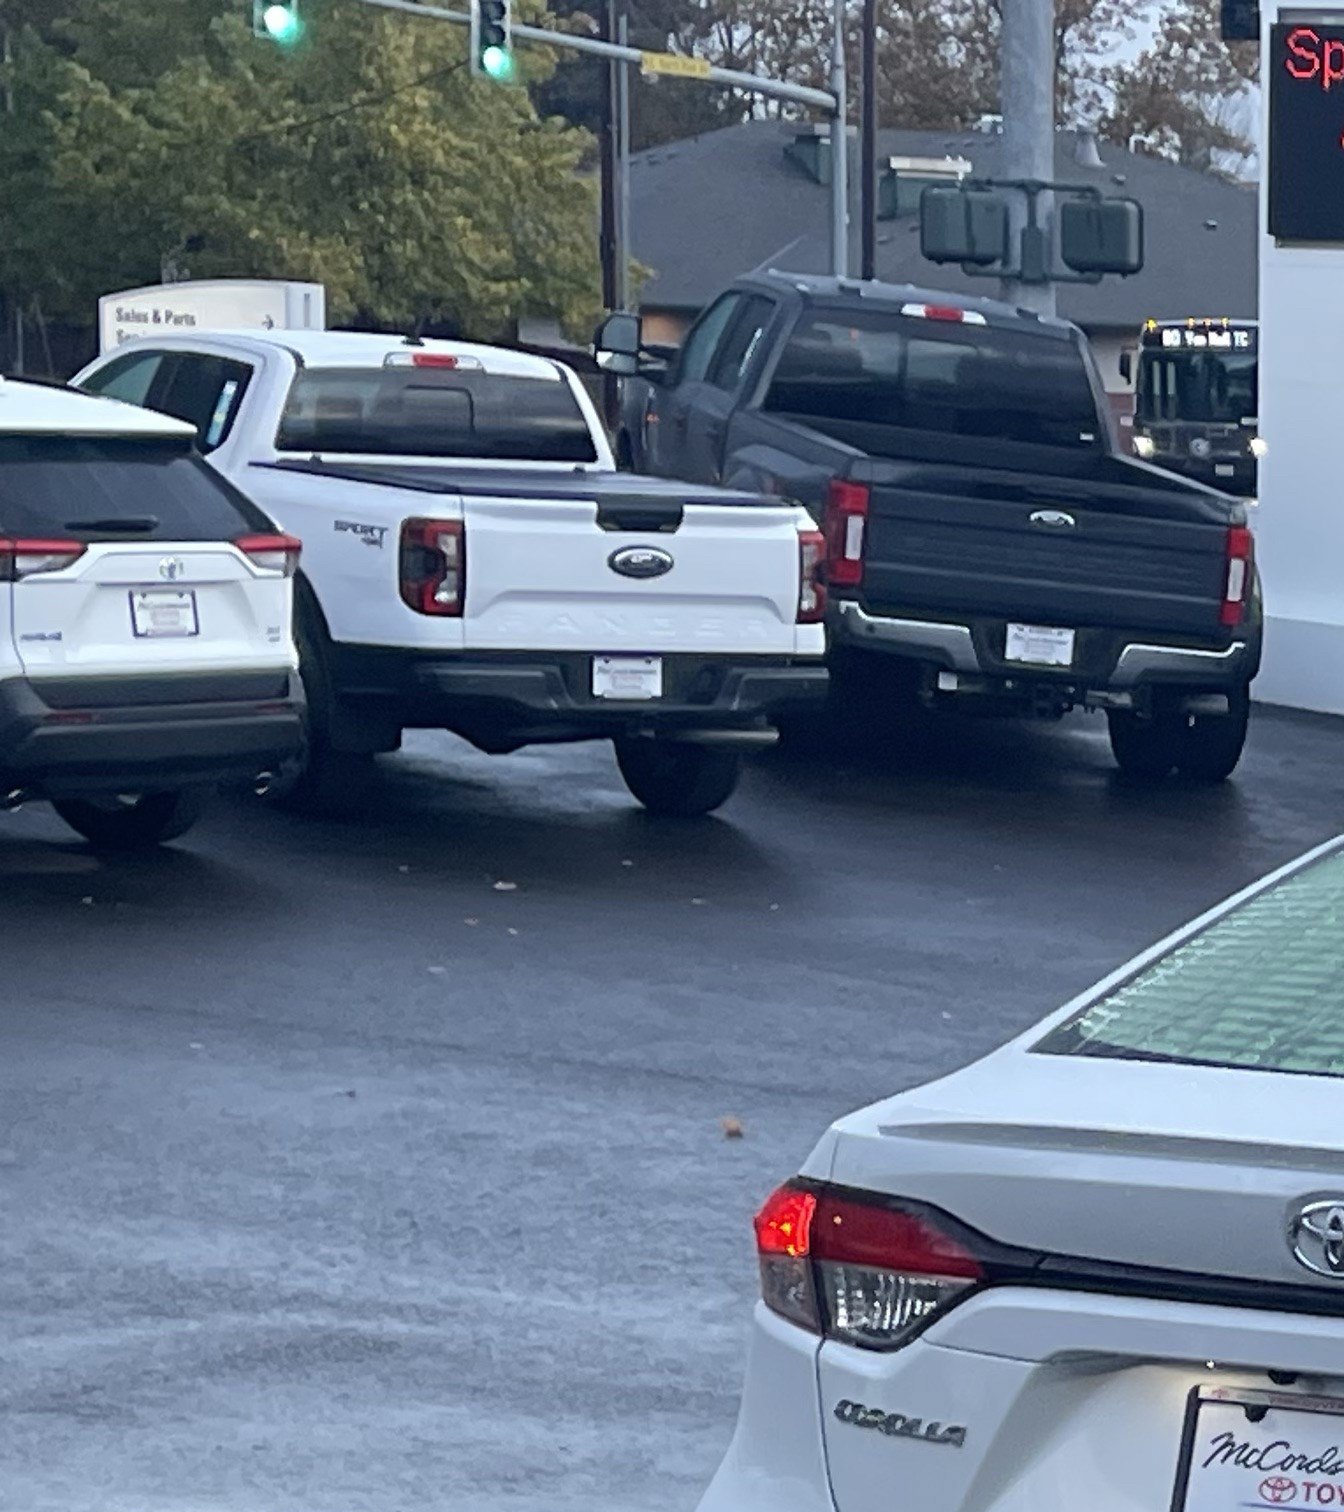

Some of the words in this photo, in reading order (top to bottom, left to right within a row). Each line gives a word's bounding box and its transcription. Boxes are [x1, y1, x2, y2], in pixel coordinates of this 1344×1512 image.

[116, 307, 149, 324] Sales
[152, 309, 161, 324] &
[165, 309, 197, 327] Parts
